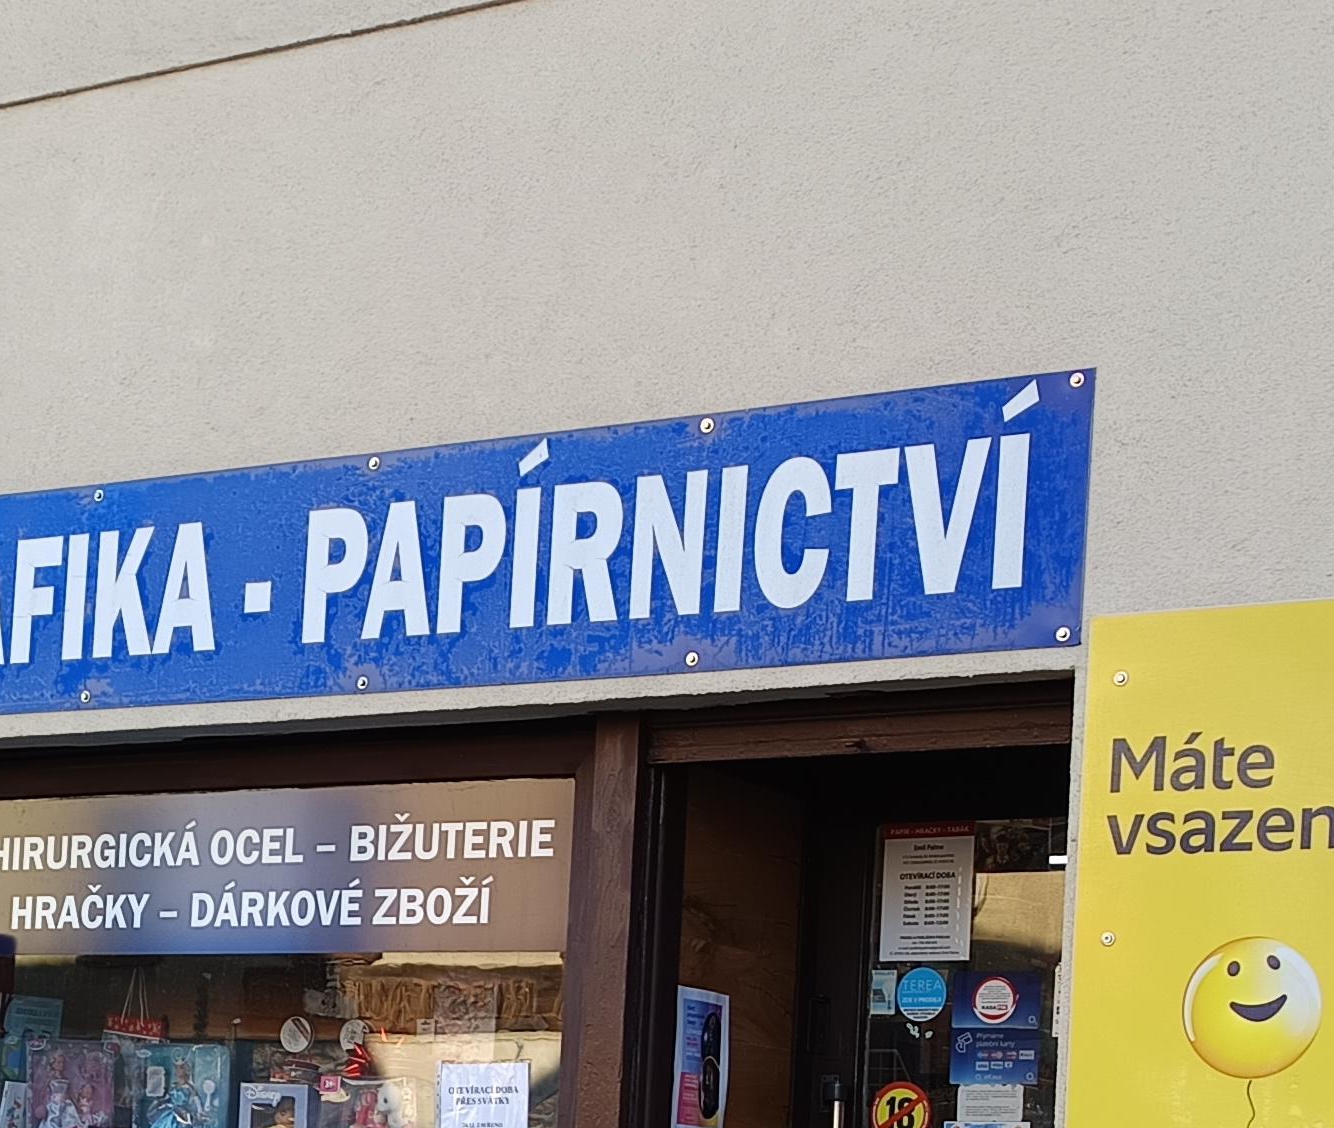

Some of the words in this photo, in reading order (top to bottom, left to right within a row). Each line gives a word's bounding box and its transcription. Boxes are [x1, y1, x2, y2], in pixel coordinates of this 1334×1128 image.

[301, 379, 1041, 645] PAPÍRNICTVÍ
[1110, 732, 1275, 793] Máte
[210, 827, 304, 866] OCEL
[350, 812, 556, 862] BIŽUTERIE
[10, 884, 151, 930] HRAČKY
[190, 877, 363, 928] DÁRKOVÉ
[372, 875, 495, 925] ZBOŽÍ
[902, 980, 943, 992] TEREA
